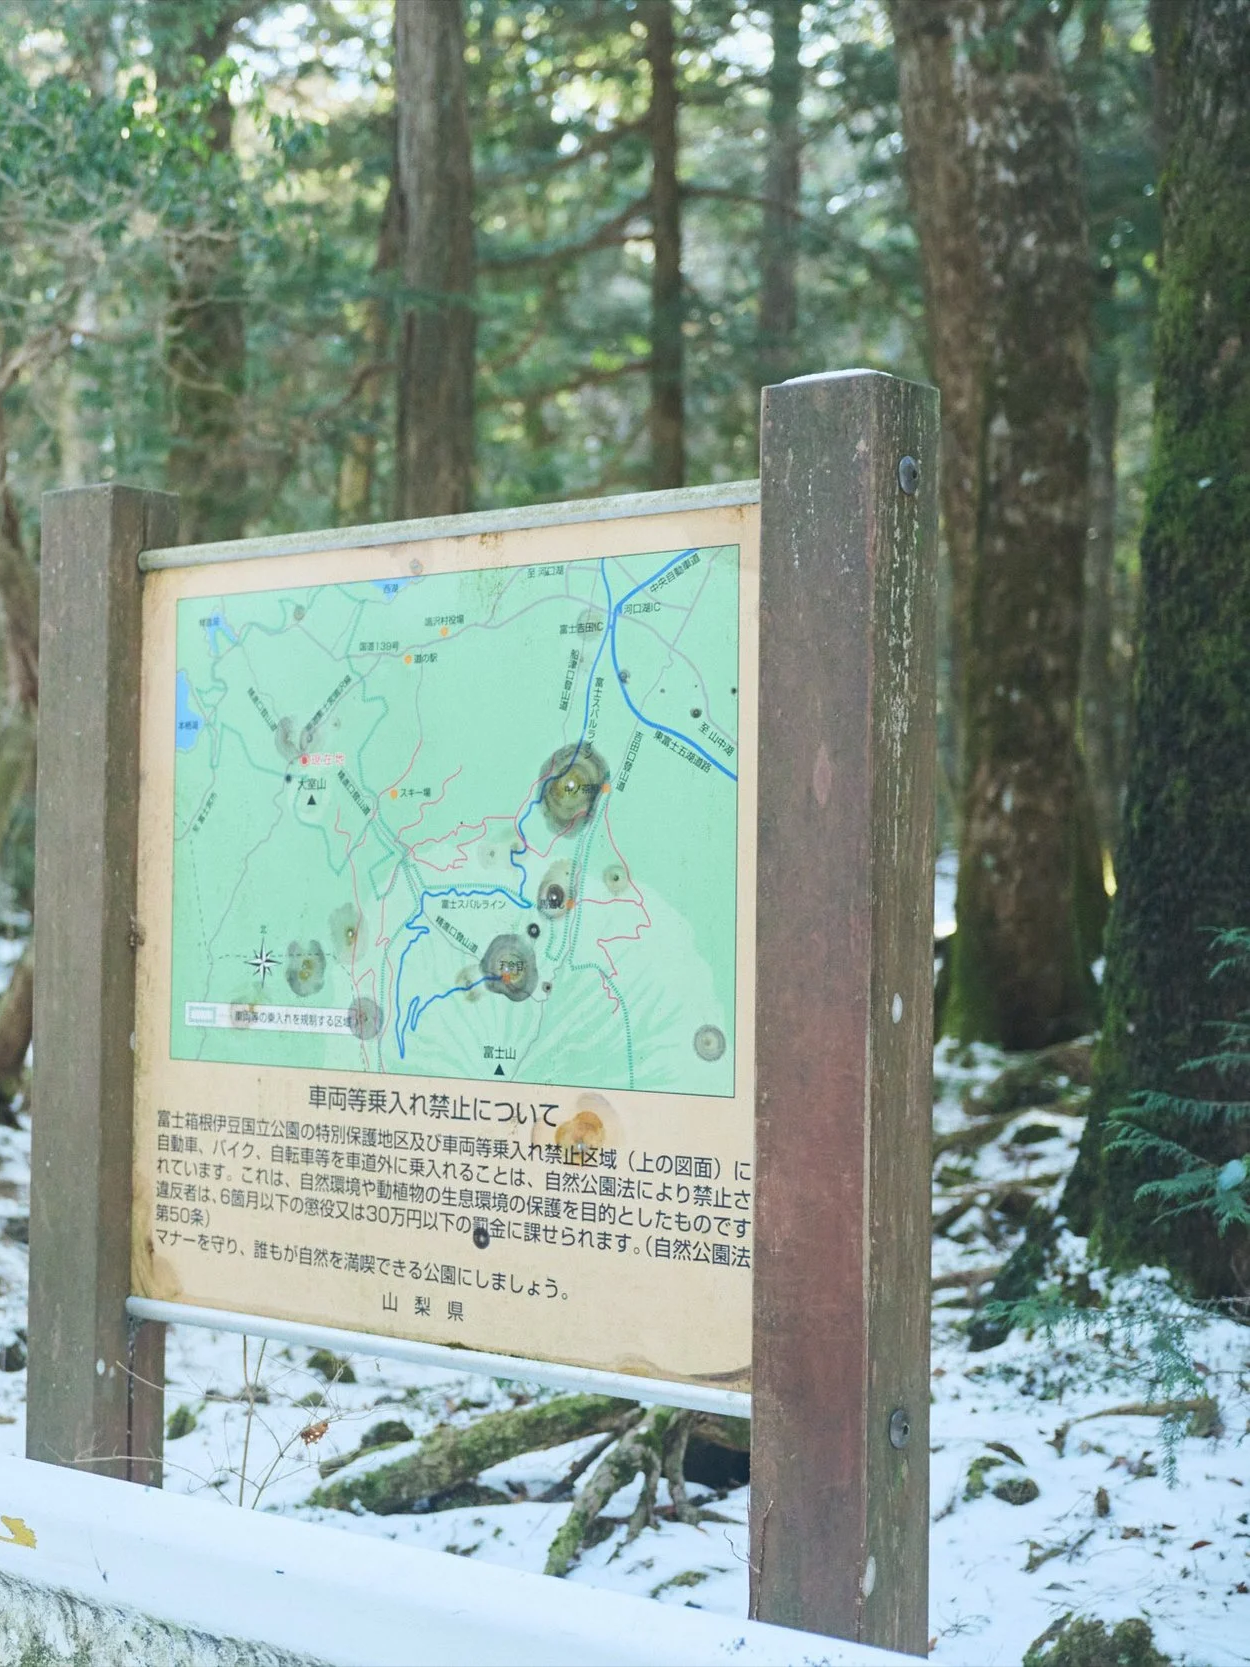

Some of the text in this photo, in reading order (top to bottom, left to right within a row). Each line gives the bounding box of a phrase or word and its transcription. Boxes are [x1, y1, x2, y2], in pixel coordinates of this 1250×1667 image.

[650, 553, 701, 593] 中央自動車道
[653, 731, 712, 773] 東富士五湖道路
[441, 899, 506, 910] 富士スバルライン
[483, 1046, 517, 1060] 富士山
[309, 1085, 559, 1127] 車両等乗入れ禁止について
